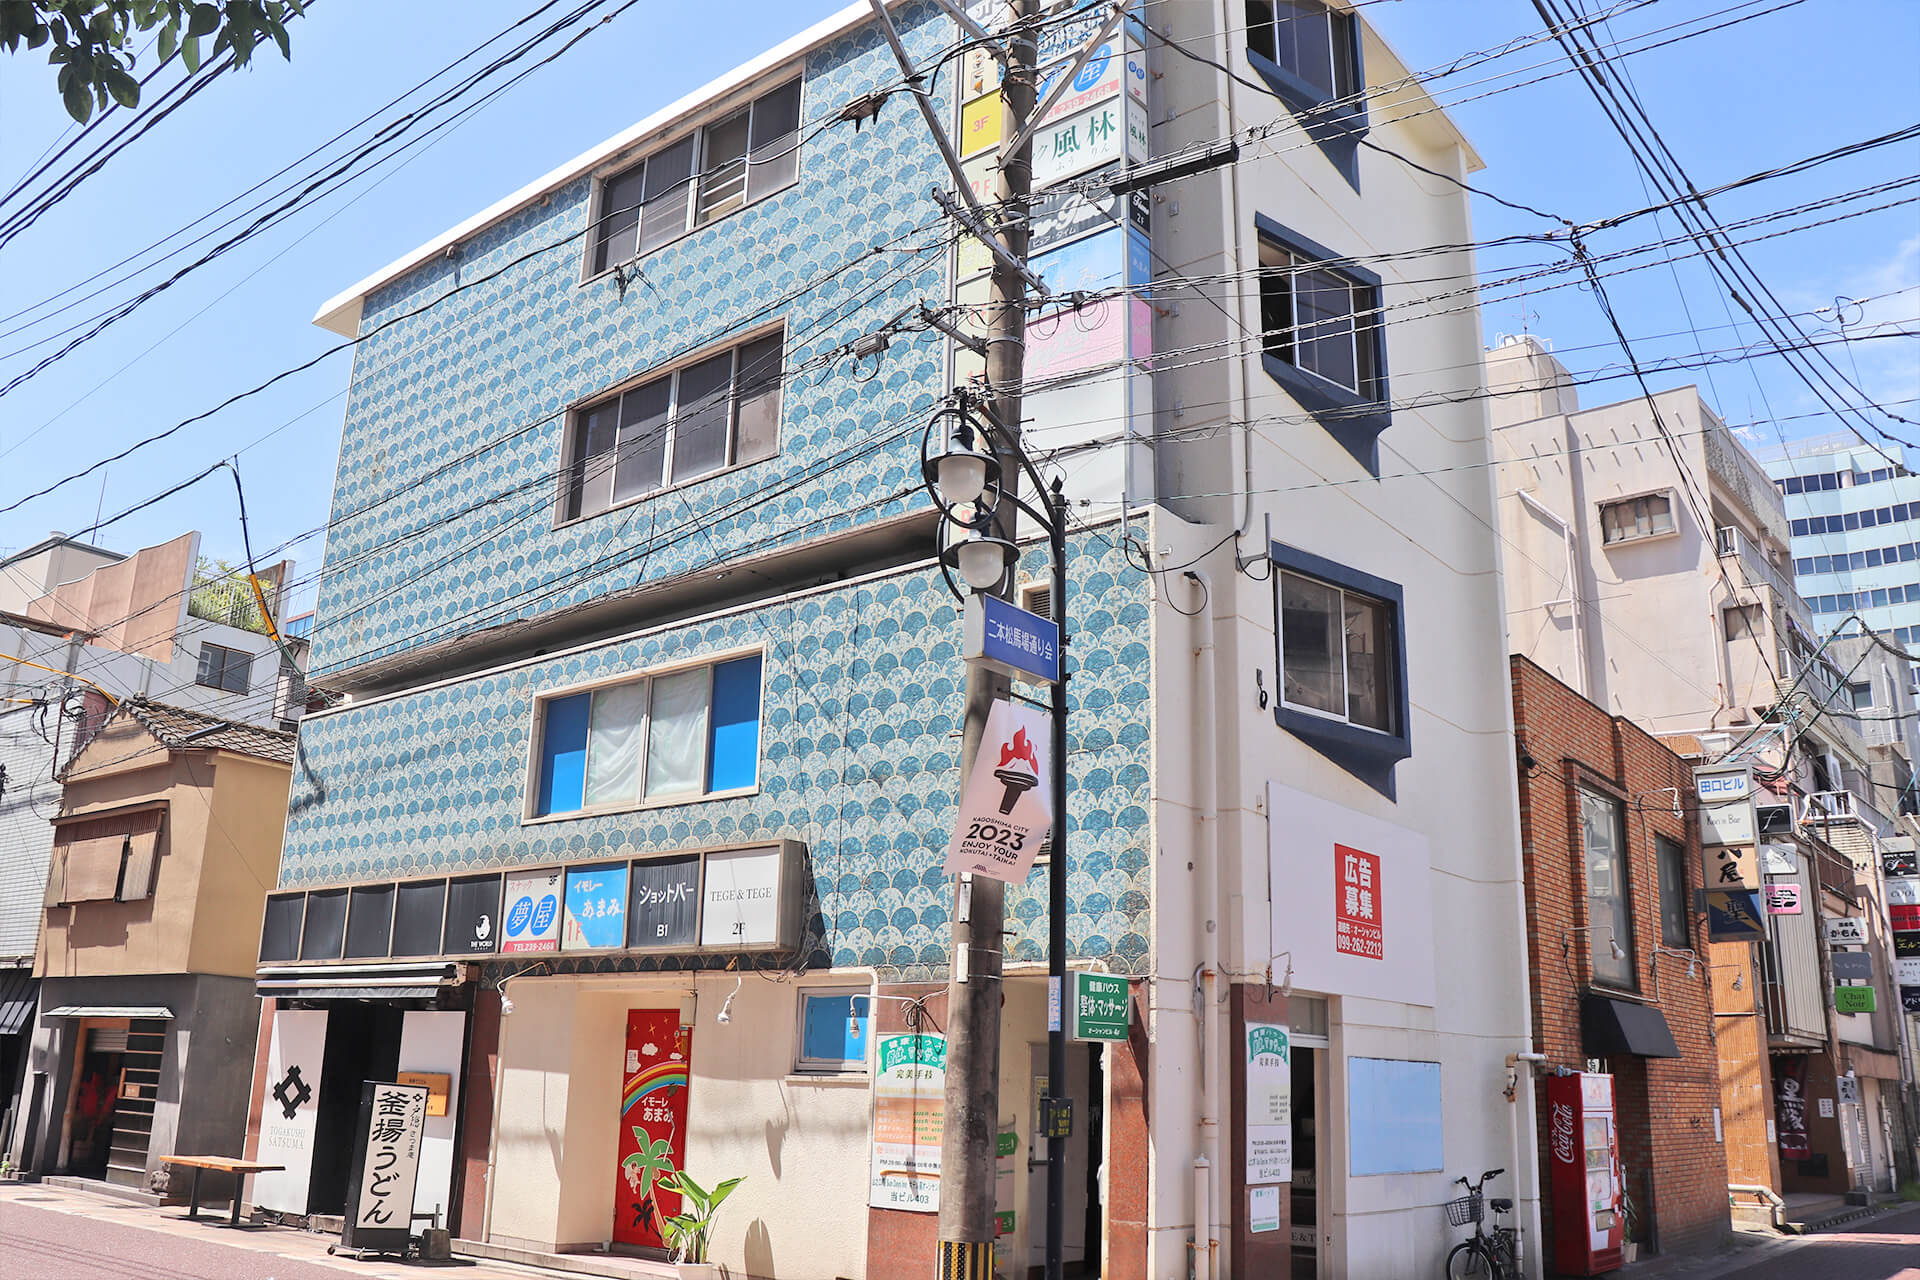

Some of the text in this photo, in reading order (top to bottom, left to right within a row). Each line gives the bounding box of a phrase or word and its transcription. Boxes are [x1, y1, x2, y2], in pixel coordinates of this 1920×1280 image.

[973, 116, 989, 132] 3F
[1053, 111, 1116, 160] 風林
[988, 618, 1053, 661] 二本松馬場通り会
[1700, 778, 1744, 792] 田口ビル
[973, 816, 1029, 833] KAGOSHIMA CITY
[966, 823, 1026, 850] 2023
[961, 841, 1018, 860] ENJOY YOUR
[1345, 854, 1372, 888] 広告
[640, 882, 694, 905] ショットバー
[711, 888, 772, 901] TEGE & TEGE
[1345, 885, 1373, 920] 募集
[510, 900, 554, 930] 夢屋
[582, 898, 624, 919] あまみ
[568, 920, 582, 941] 1F
[656, 924, 668, 937] B1
[732, 922, 745, 934] 2F
[1337, 934, 1382, 956] 099-262-2212
[641, 1096, 669, 1107] イモーレ
[643, 1107, 674, 1123] あまみ
[1552, 1101, 1575, 1164] Coca-Cola
[362, 1090, 410, 1225] 釜揚うどん
